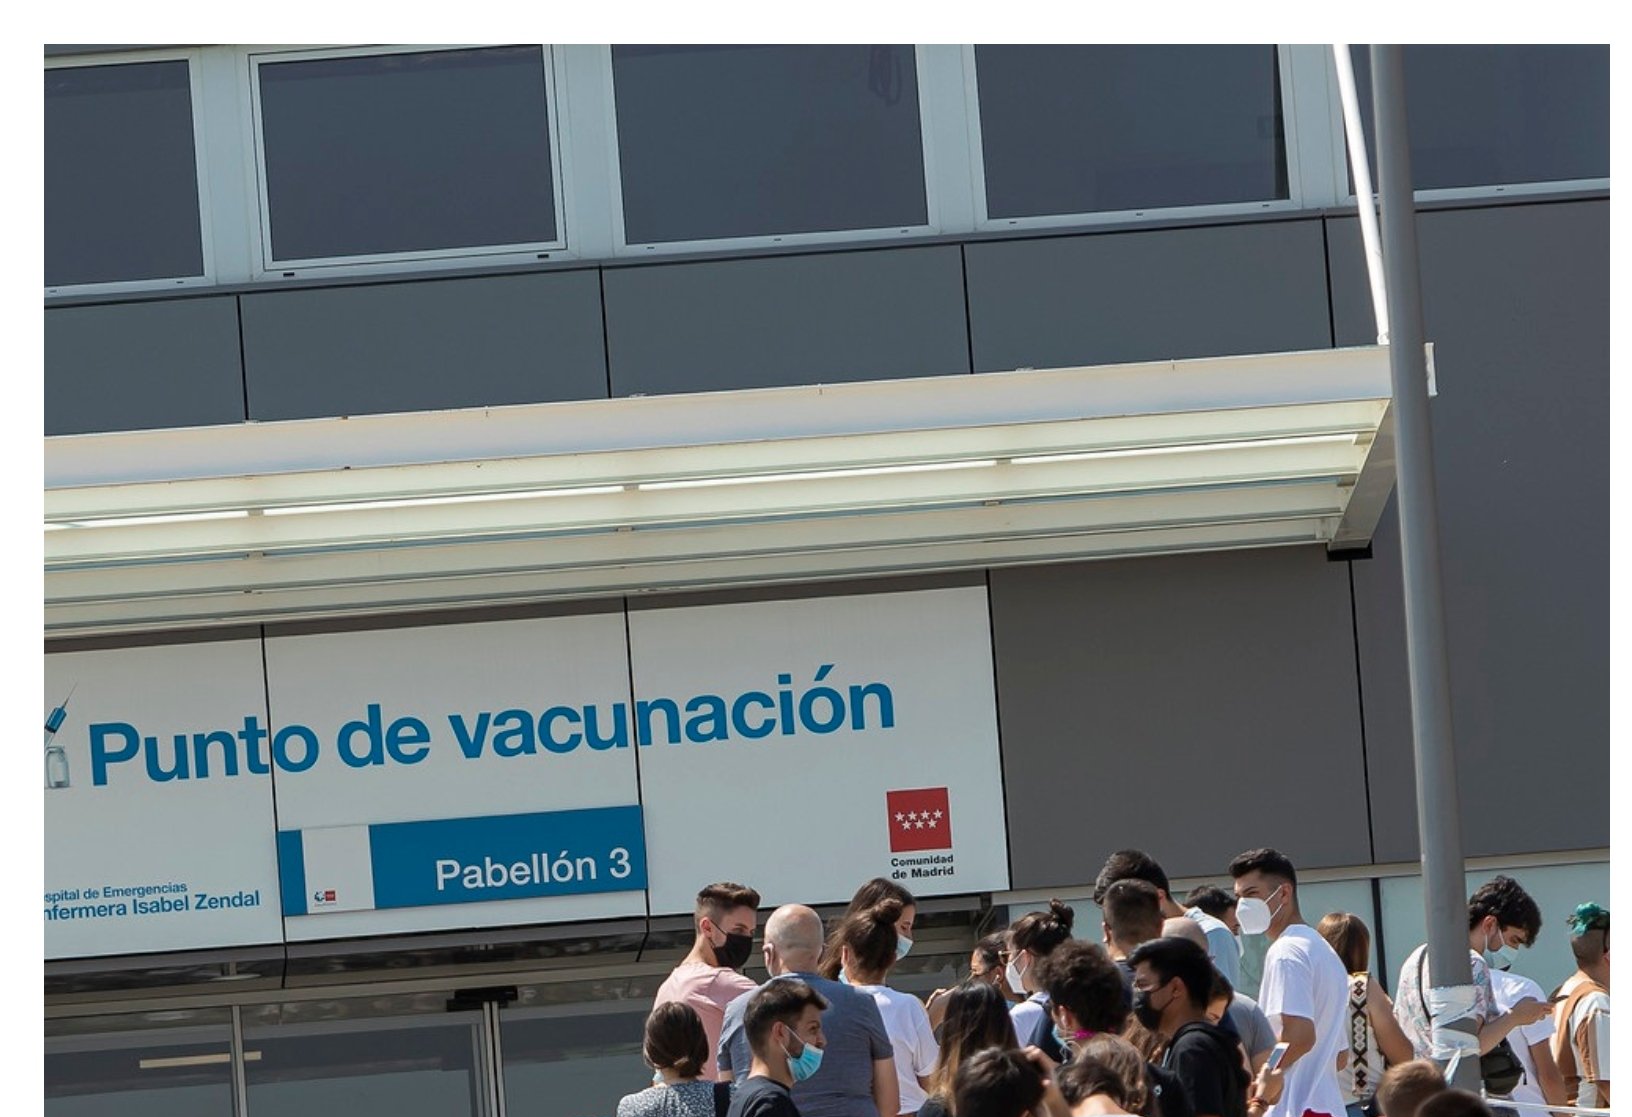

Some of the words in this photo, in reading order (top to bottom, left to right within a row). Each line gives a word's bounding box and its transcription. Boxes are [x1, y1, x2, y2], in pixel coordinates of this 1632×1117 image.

[88, 714, 320, 788] Punto
[336, 703, 431, 768] de
[447, 663, 896, 760] vacunación
[435, 850, 598, 891] Pabellón
[608, 847, 632, 879] 3
[890, 854, 954, 867] Comunidad
[891, 869, 908, 880] de
[911, 866, 954, 878] Madrid
[83, 887, 100, 900] de
[103, 881, 188, 898] Emergencias
[133, 895, 189, 914] Isabel
[194, 890, 260, 910] Zendal
